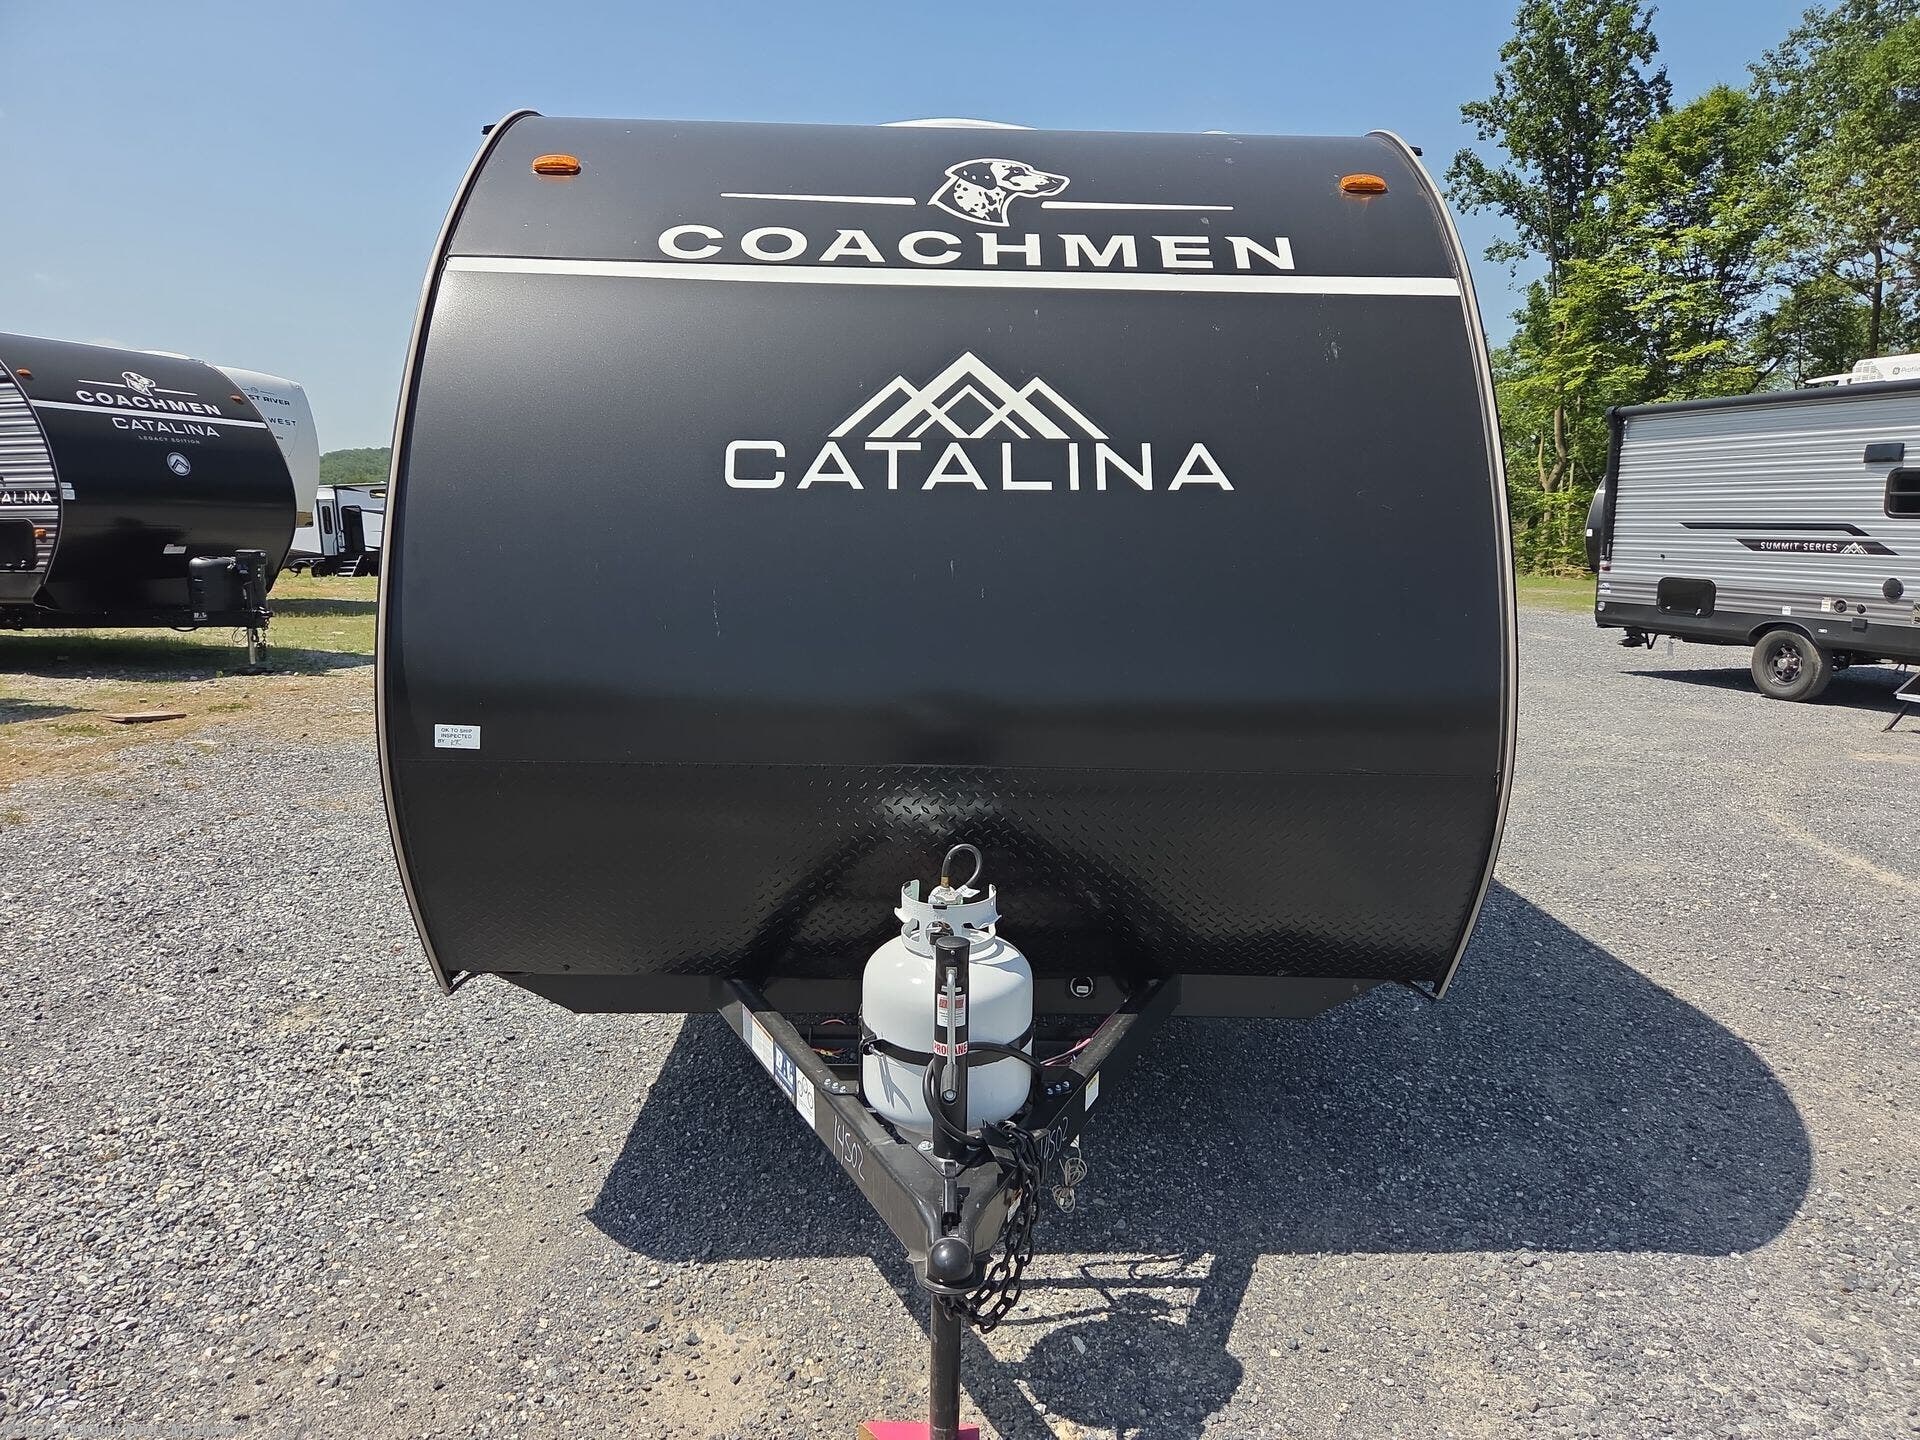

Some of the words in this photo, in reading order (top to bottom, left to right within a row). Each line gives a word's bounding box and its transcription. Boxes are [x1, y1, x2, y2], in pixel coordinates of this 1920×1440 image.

[657, 223, 1296, 270] COACHMEN
[76, 390, 221, 416] COACHMEN
[263, 396, 290, 406] RIVER
[112, 417, 220, 437] CATALINA
[267, 417, 296, 426] WEST
[723, 439, 1236, 492] CATALINA
[0, 490, 53, 504] ALINA
[1760, 541, 1799, 550] SUMMIT
[1803, 543, 1838, 551] SERIES
[934, 1041, 968, 1055] PROANE
[833, 1114, 865, 1181] 14502
